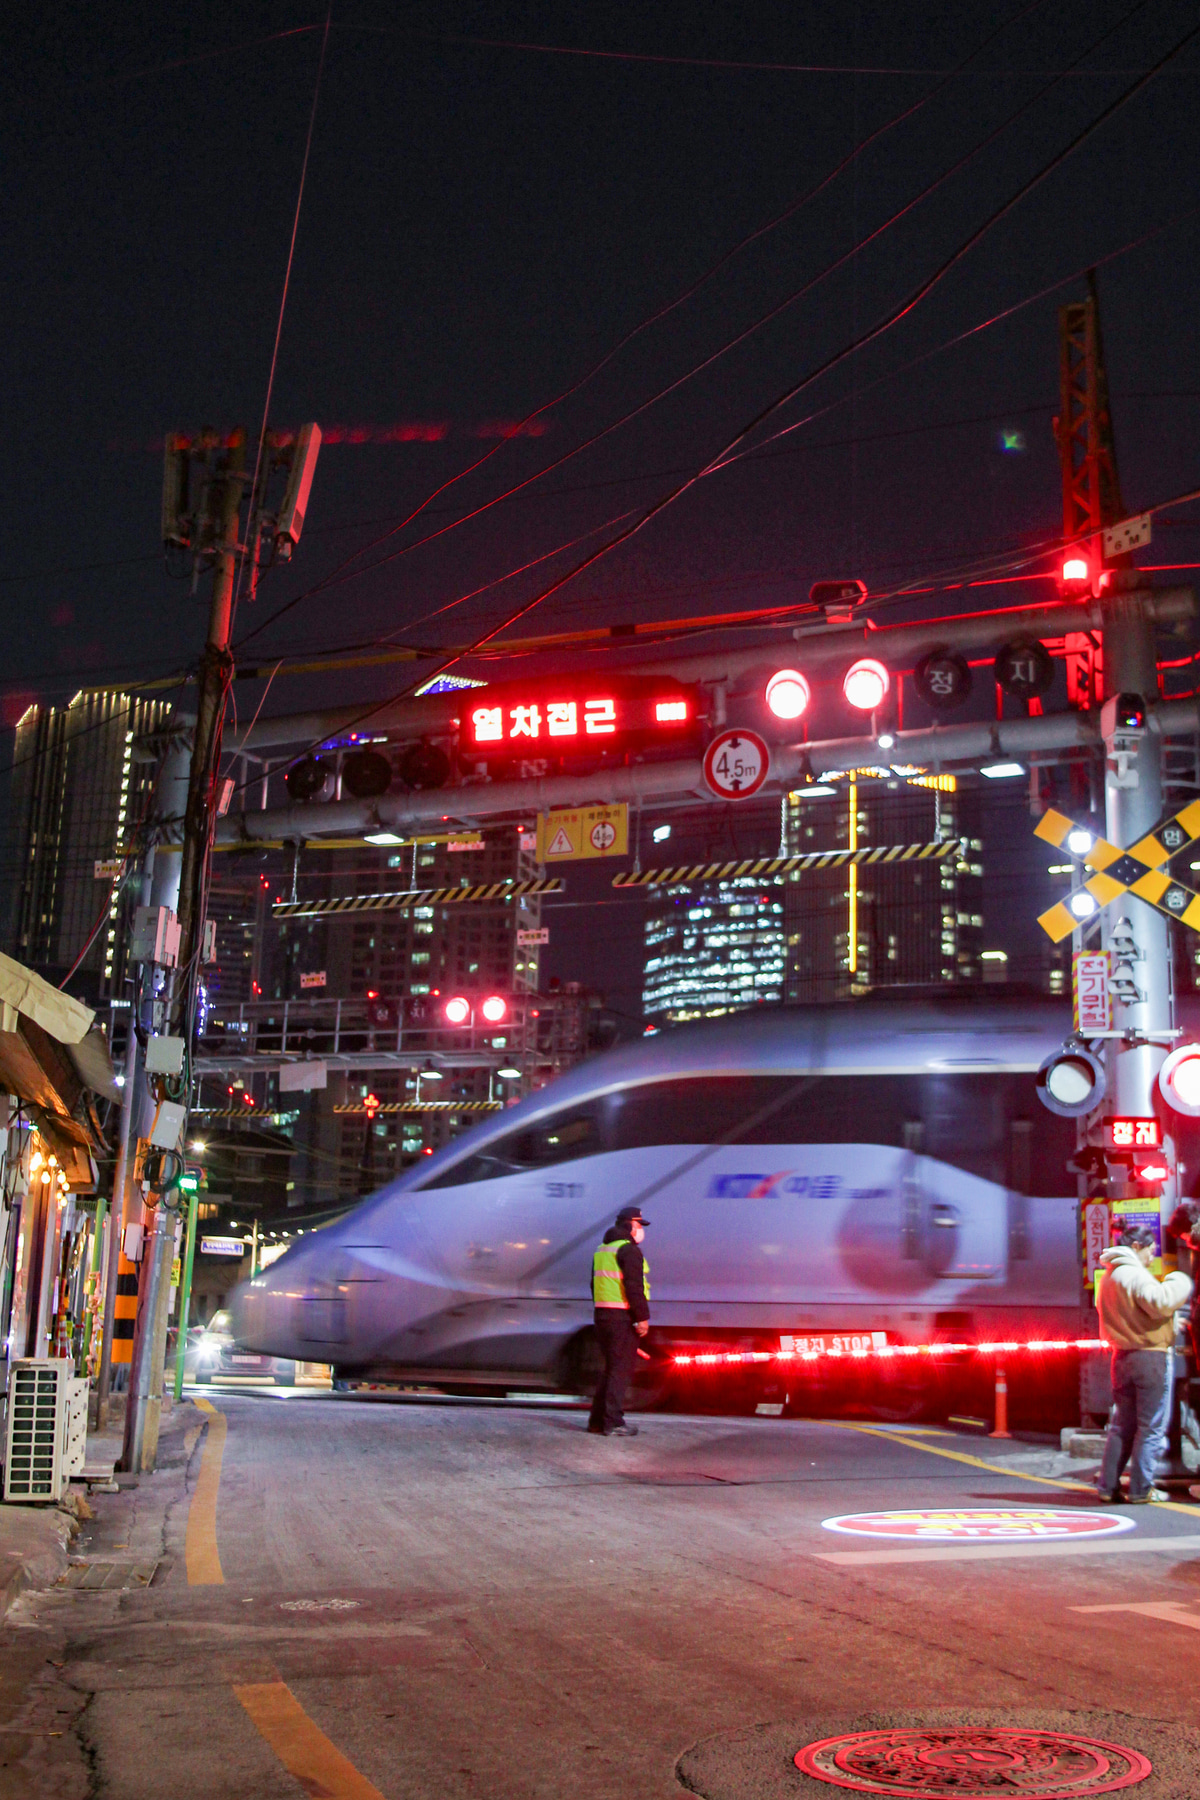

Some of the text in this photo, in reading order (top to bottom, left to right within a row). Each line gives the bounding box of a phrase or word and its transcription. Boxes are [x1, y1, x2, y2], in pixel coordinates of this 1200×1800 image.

[472, 700, 616, 741] 열차접근
[716, 752, 756, 779] 4.5m
[1080, 960, 1107, 1028] 전기위험
[1113, 1122, 1157, 1145] 정지
[832, 1335, 872, 1352] STOP
